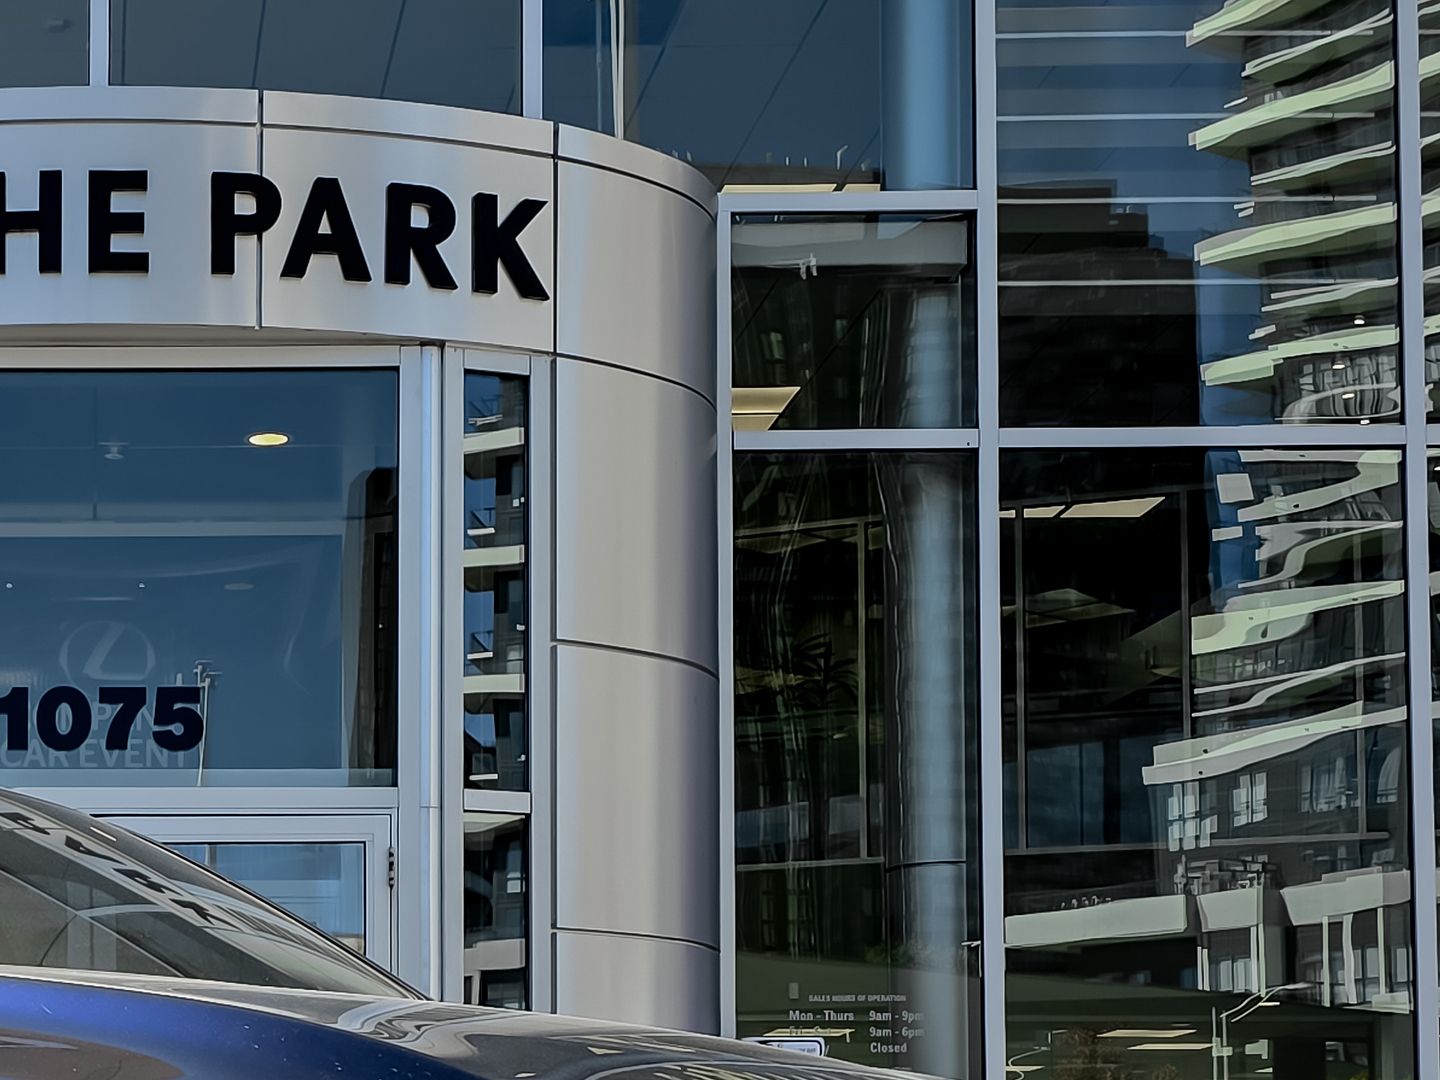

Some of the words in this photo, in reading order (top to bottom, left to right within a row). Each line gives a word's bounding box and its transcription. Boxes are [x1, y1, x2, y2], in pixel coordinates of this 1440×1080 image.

[210, 170, 551, 302] PARK
[789, 1010, 814, 1021] Mon
[823, 1010, 855, 1021] Thurs
[869, 1010, 892, 1021] 9am
[901, 1010, 925, 1024] 9pm
[869, 1026, 892, 1037] 9am
[901, 1026, 925, 1039] 6pm
[870, 1042, 907, 1053] Closed
